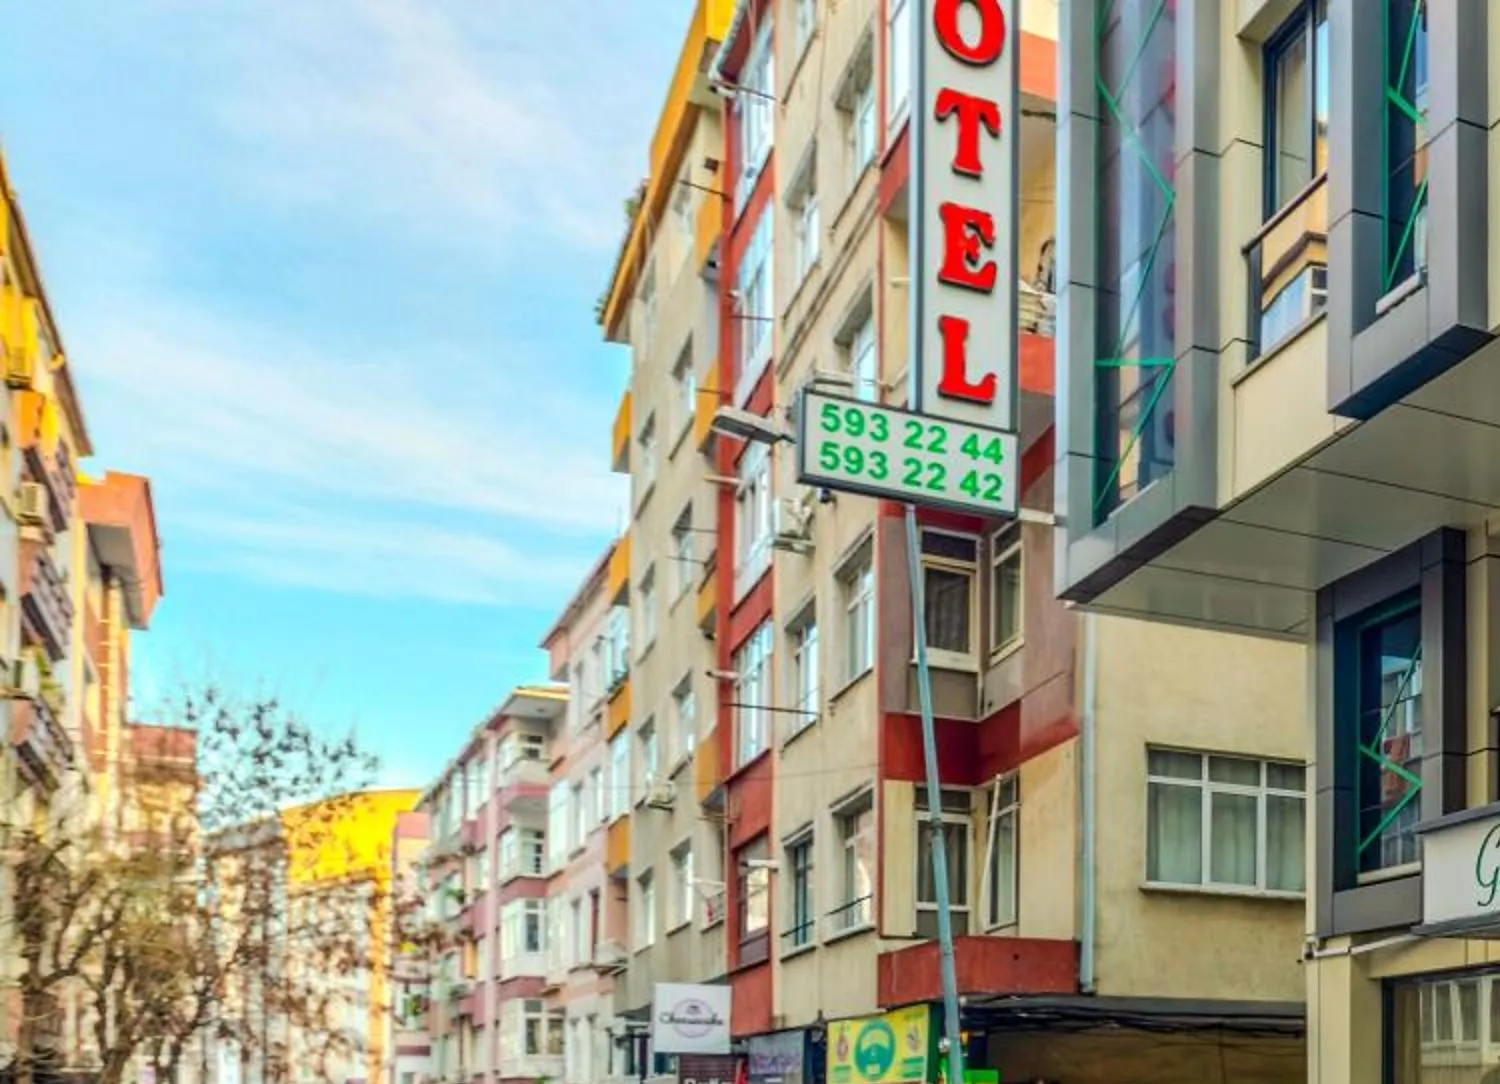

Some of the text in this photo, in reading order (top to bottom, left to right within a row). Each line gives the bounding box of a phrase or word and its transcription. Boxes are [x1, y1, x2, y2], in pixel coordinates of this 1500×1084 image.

[819, 403, 1004, 466] 593 22 44
[818, 440, 1004, 504] 593 22 42
